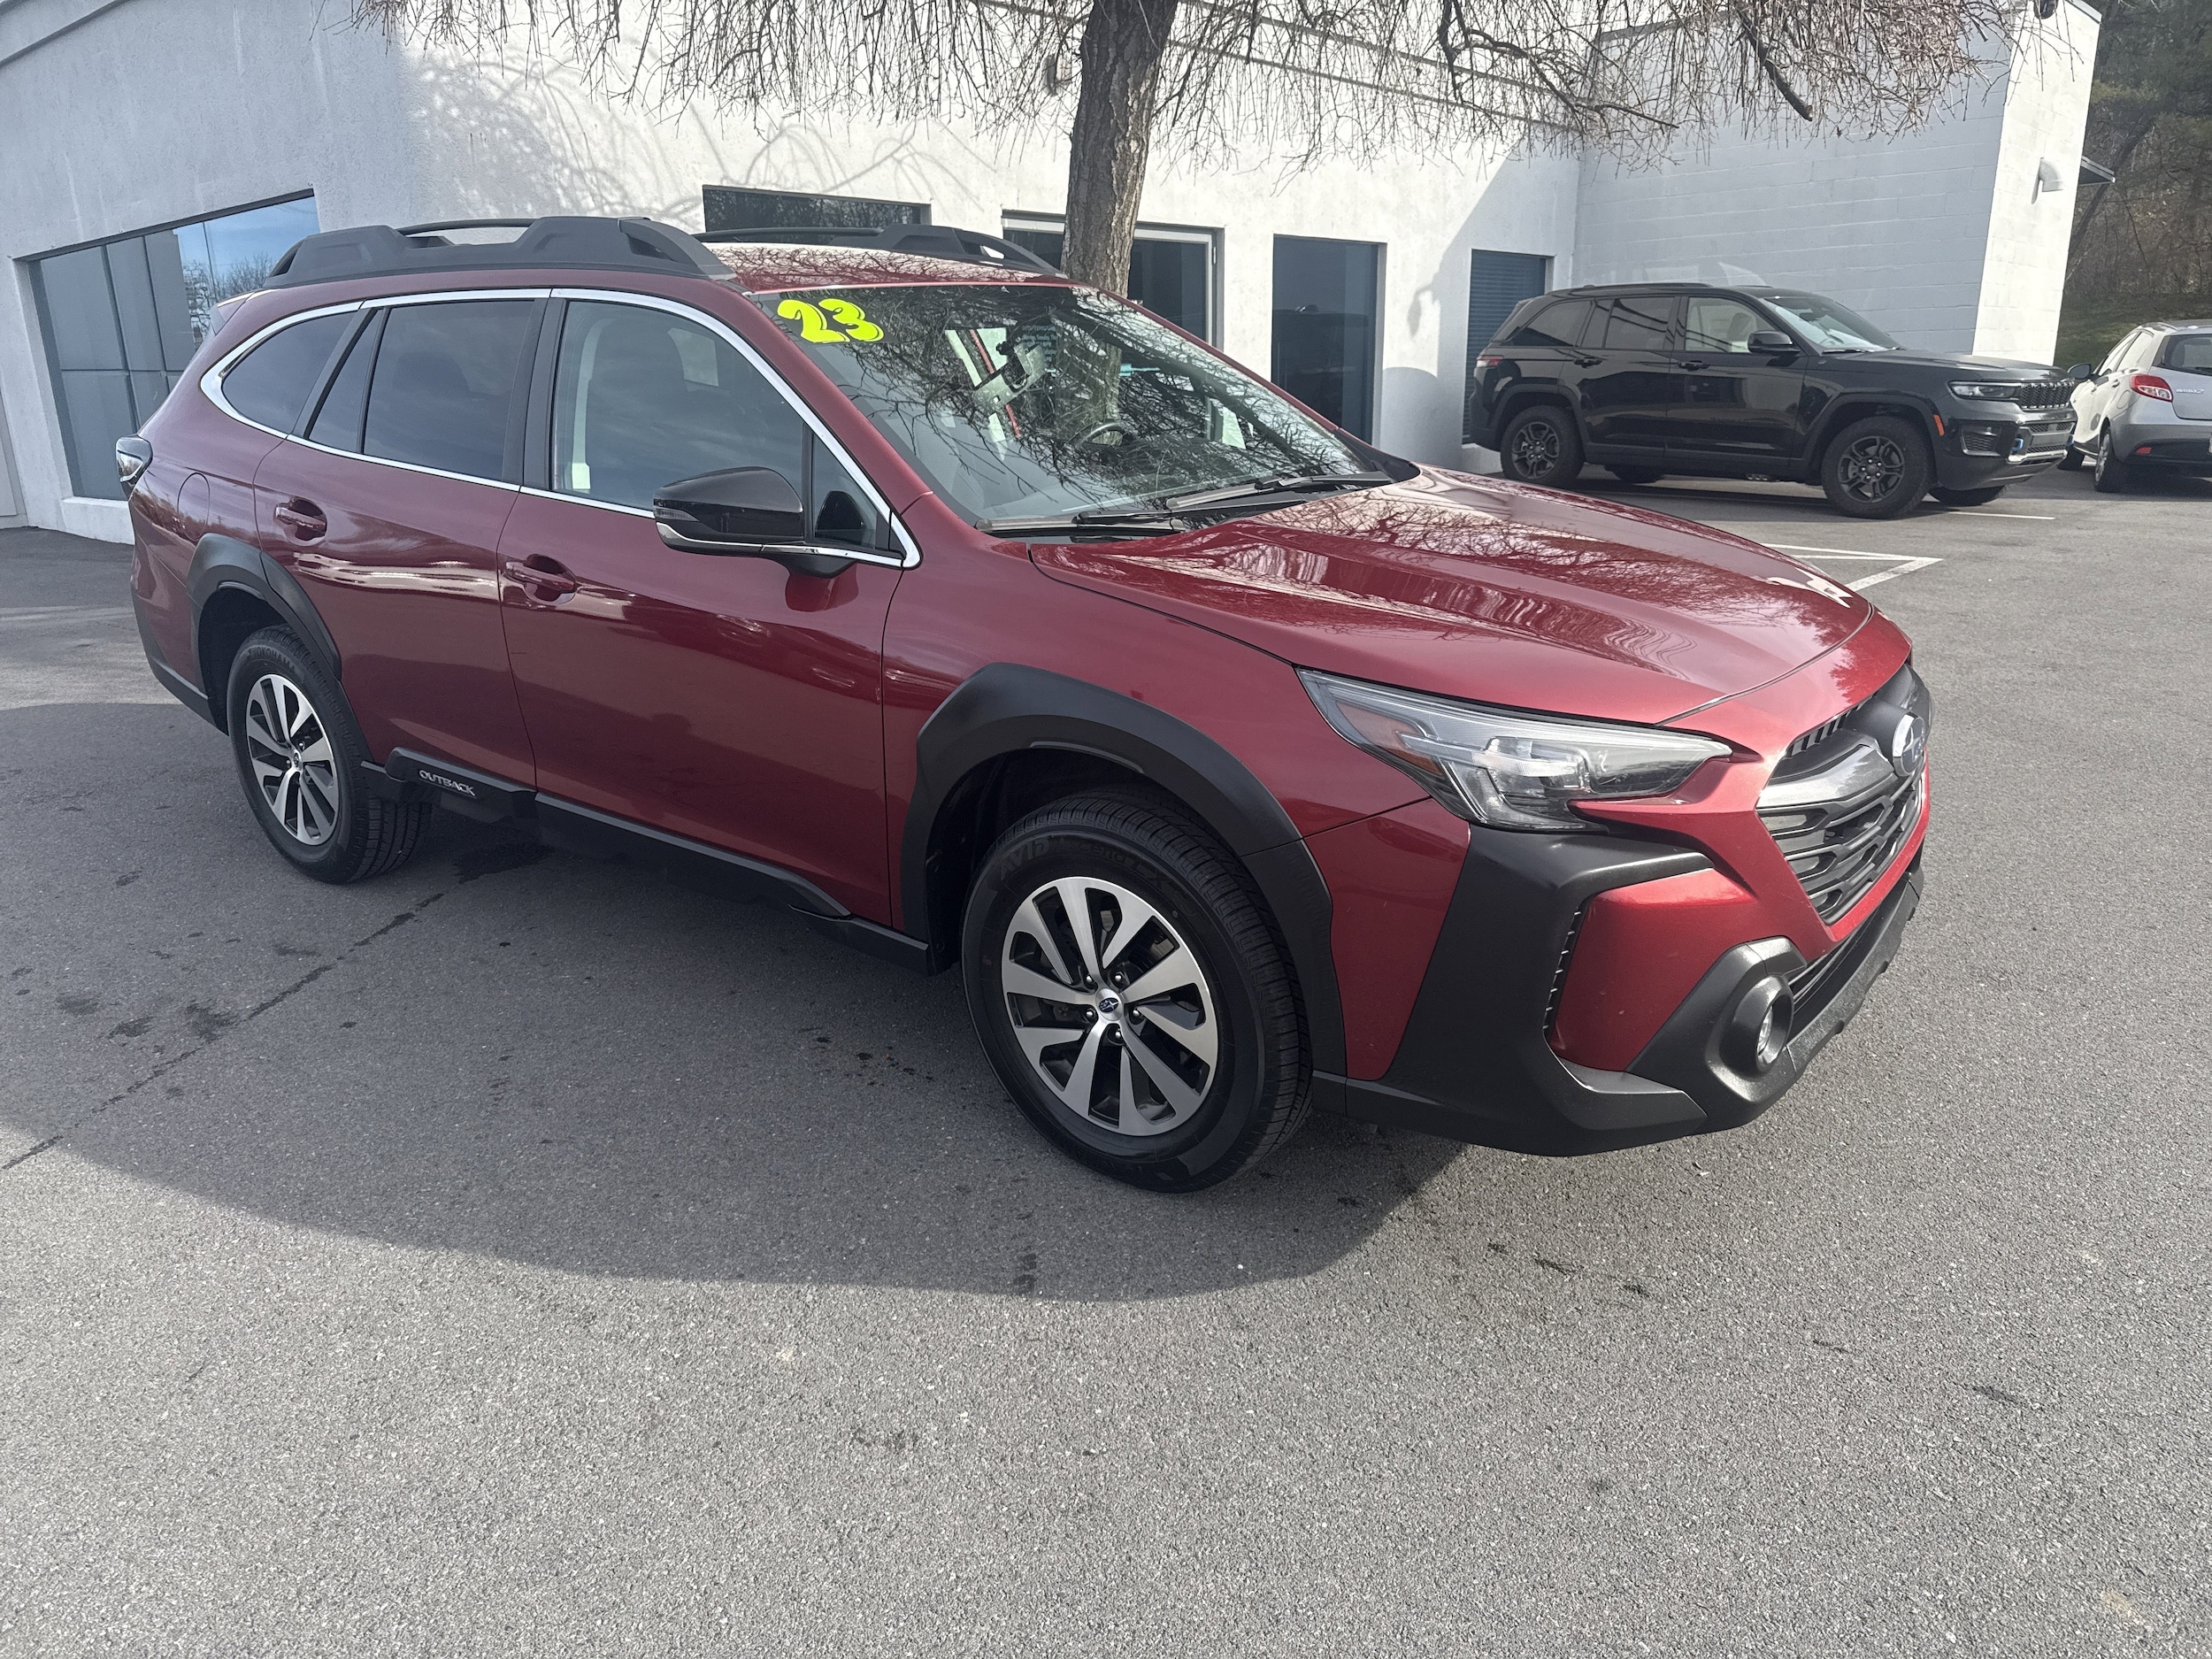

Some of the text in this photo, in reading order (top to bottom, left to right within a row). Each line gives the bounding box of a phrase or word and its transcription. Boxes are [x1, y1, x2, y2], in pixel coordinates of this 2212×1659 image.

[777, 298, 884, 343] 23
[251, 646, 296, 673] YOKOHAMA
[419, 770, 475, 796] OUTBACK
[1000, 838, 1050, 881] AVID
